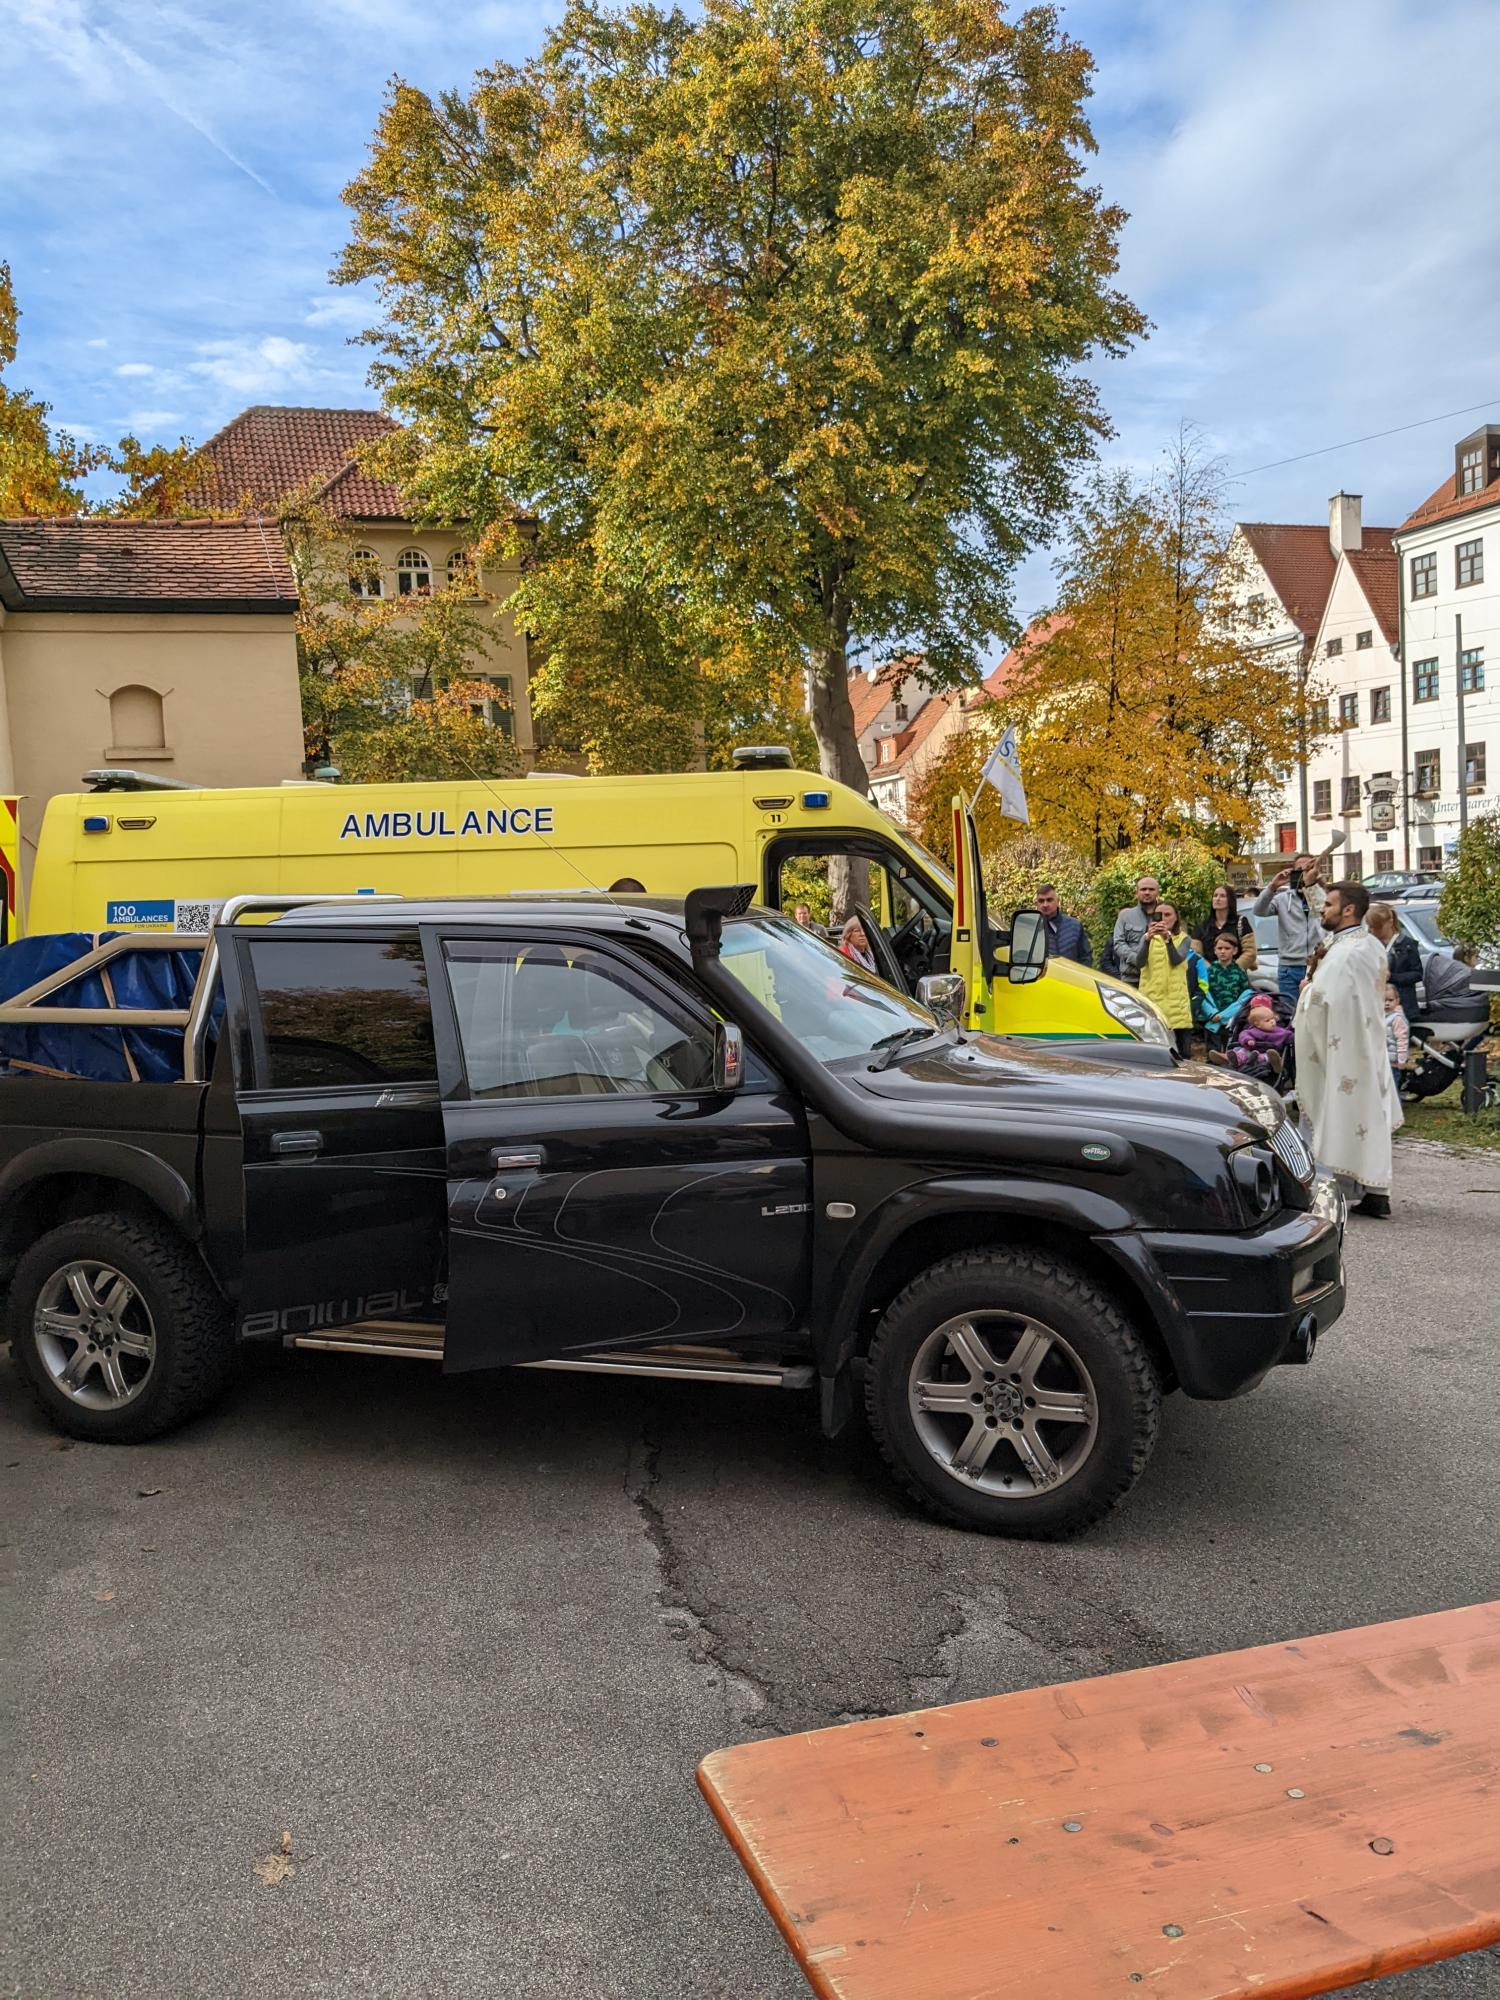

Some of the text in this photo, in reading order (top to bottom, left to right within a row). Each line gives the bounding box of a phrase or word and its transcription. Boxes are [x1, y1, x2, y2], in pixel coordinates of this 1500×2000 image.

[340, 807, 554, 839] AMBULANCE
[770, 814, 782, 823] 11
[112, 905, 136, 917] 100
[112, 914, 169, 923] AMBULANCES
